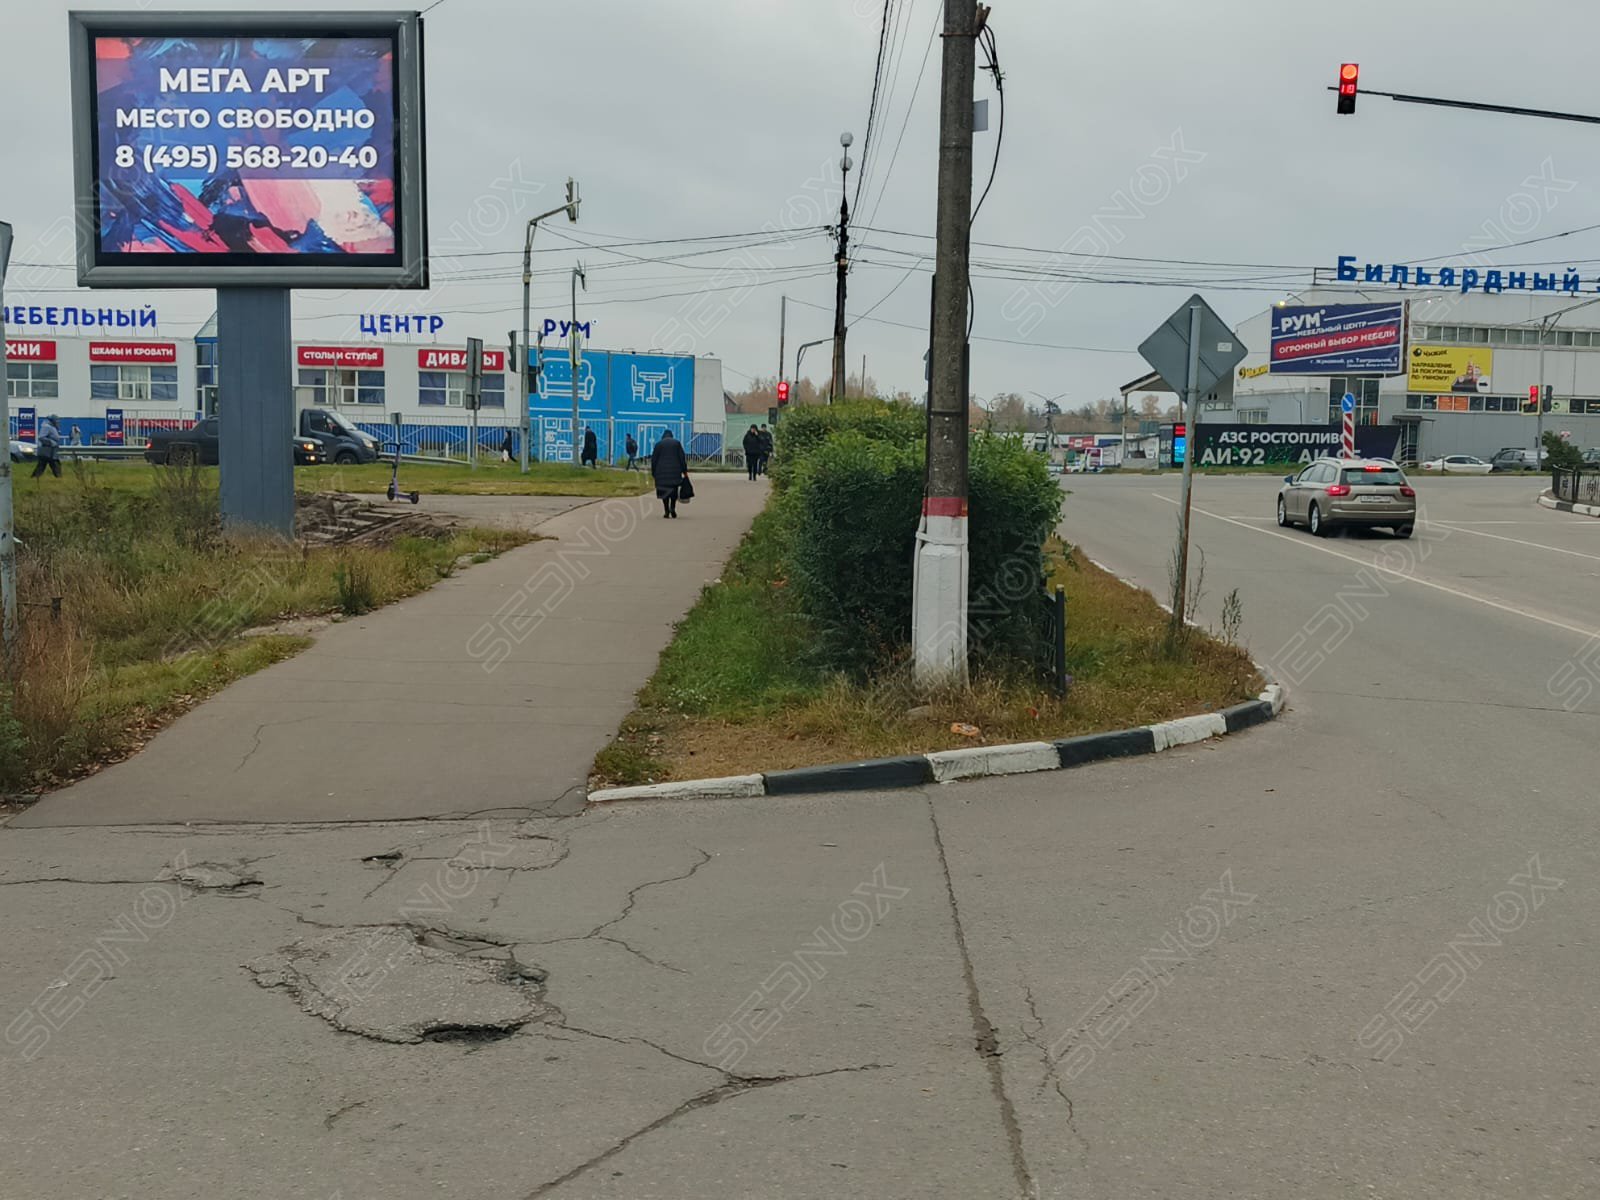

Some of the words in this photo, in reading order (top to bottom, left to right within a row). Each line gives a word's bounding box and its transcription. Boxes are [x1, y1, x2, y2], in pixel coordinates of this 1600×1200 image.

[160, 68, 250, 93] МЕГА
[262, 68, 330, 93] АРТ
[116, 109, 210, 128] МЕСТО
[217, 108, 375, 132] СВОБОДНО
[115, 146, 134, 168] 8
[143, 145, 217, 173] (495)
[226, 145, 378, 168] 568-20-40
[1337, 255, 1580, 294] Бильярдный
[360, 314, 444, 335] ЦЕНТР
[544, 319, 590, 339] РУМ
[1281, 312, 1321, 333] РУМ
[4, 343, 40, 356] ХНИ
[91, 347, 124, 357] ШКАФЫ
[125, 348, 132, 357] И
[134, 348, 173, 358] КРОВАТИ
[1279, 339, 1327, 354] ОГРОМНЫЙ
[1328, 335, 1359, 347] ВЫБОР
[1360, 329, 1396, 343] МЕБЕЛИ
[303, 351, 335, 360] СТОЛЫ
[336, 352, 343, 360] И
[345, 352, 378, 361] СТУЛЬЯ
[1219, 431, 1247, 444] АЗС
[1200, 448, 1265, 465] АИ-92
